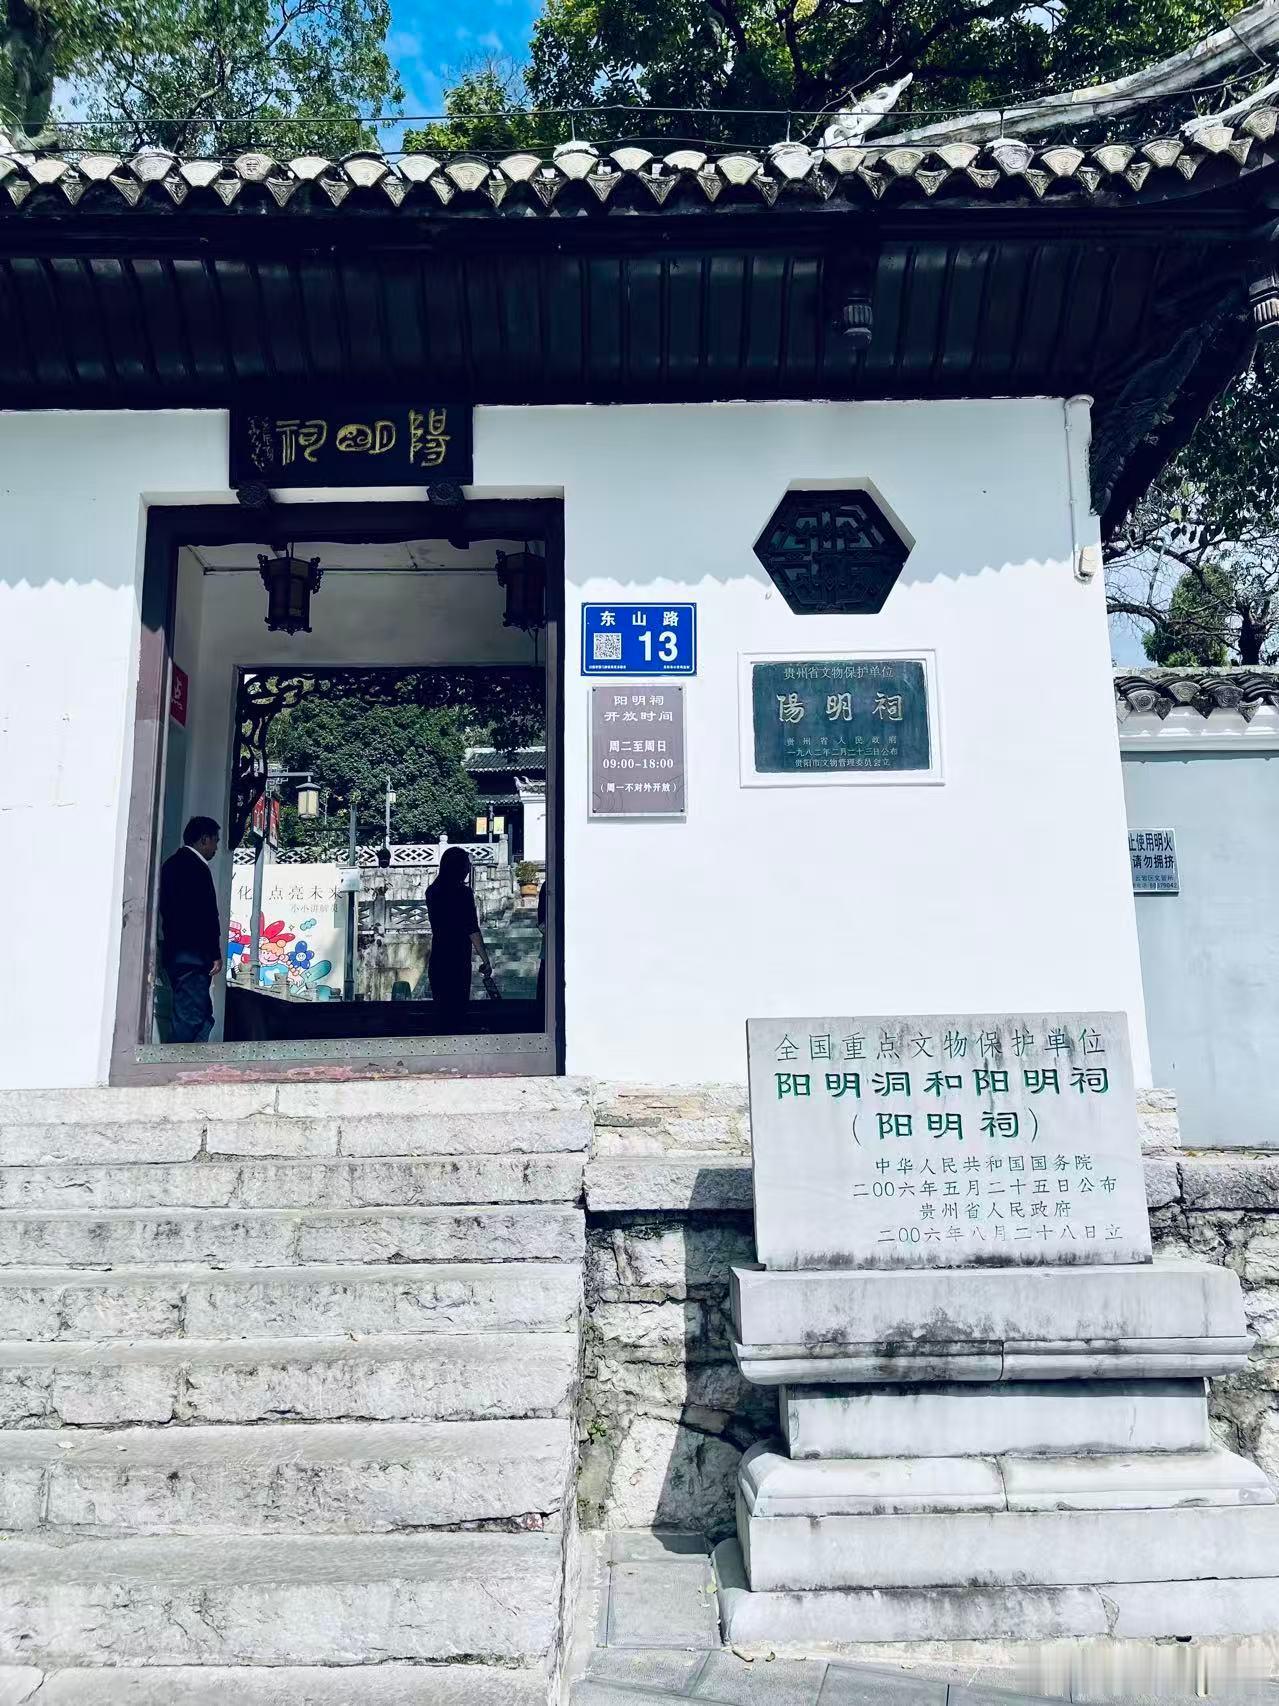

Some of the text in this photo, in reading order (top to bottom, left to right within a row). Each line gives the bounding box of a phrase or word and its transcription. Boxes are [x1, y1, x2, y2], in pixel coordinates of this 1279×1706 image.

[600, 611, 680, 627] 东山路
[638, 630, 679, 662] 13
[784, 666, 894, 681] 贵州省文物保护单位
[613, 695, 665, 706] 阳明祠
[776, 691, 904, 724] 陽明祠
[603, 711, 674, 722] 开放时间
[609, 740, 667, 753] 周二至周日
[786, 735, 898, 747] 贵州省人民政府
[602, 758, 675, 769] 09:00-18:00
[1132, 855, 1174, 869] 请勿拥挤
[775, 1027, 1106, 1062] 全国重点文物保护单位
[774, 1066, 1109, 1100] 阳明洞和阳明祠
[875, 1155, 1093, 1175] 中华人民共和国国务院
[919, 1200, 1073, 1220] 贵州省人民政府
